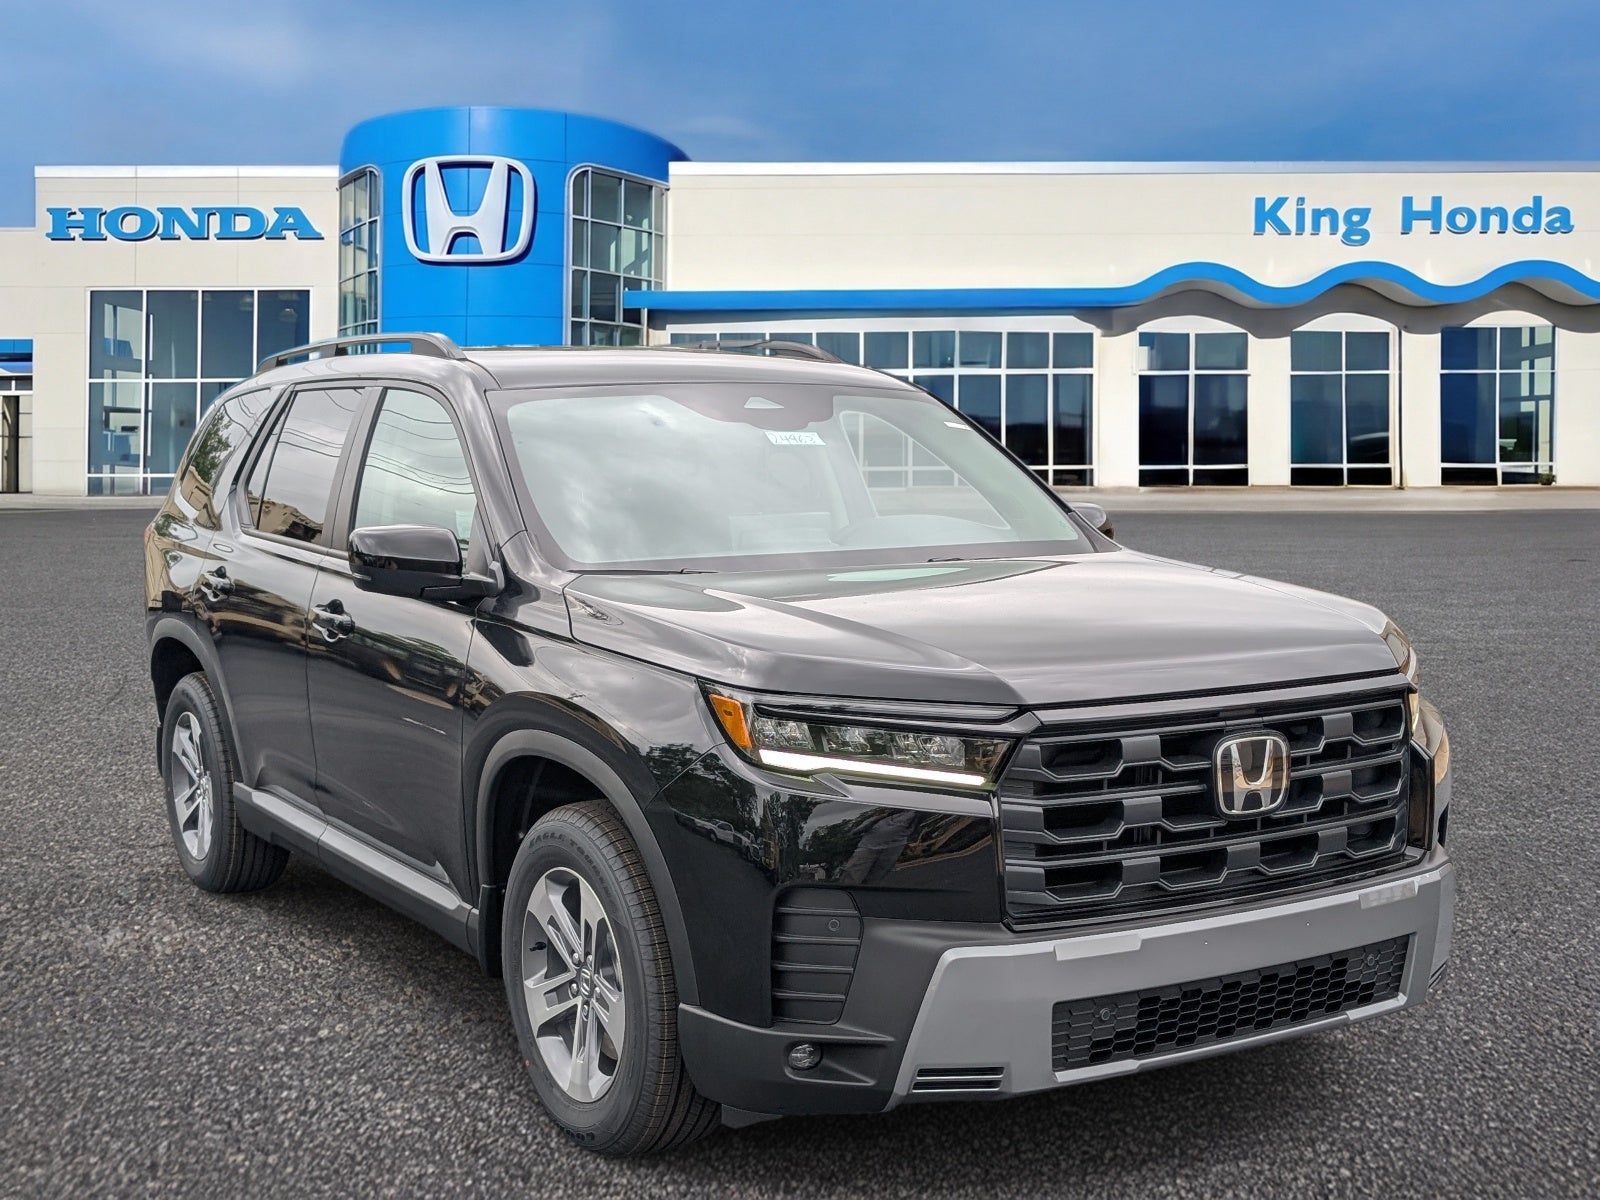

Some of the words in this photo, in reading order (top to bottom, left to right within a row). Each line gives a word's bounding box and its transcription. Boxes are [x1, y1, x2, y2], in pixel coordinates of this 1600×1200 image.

[46, 205, 323, 241] HONDA
[1254, 195, 1372, 246] King
[1401, 195, 1575, 235] Honda
